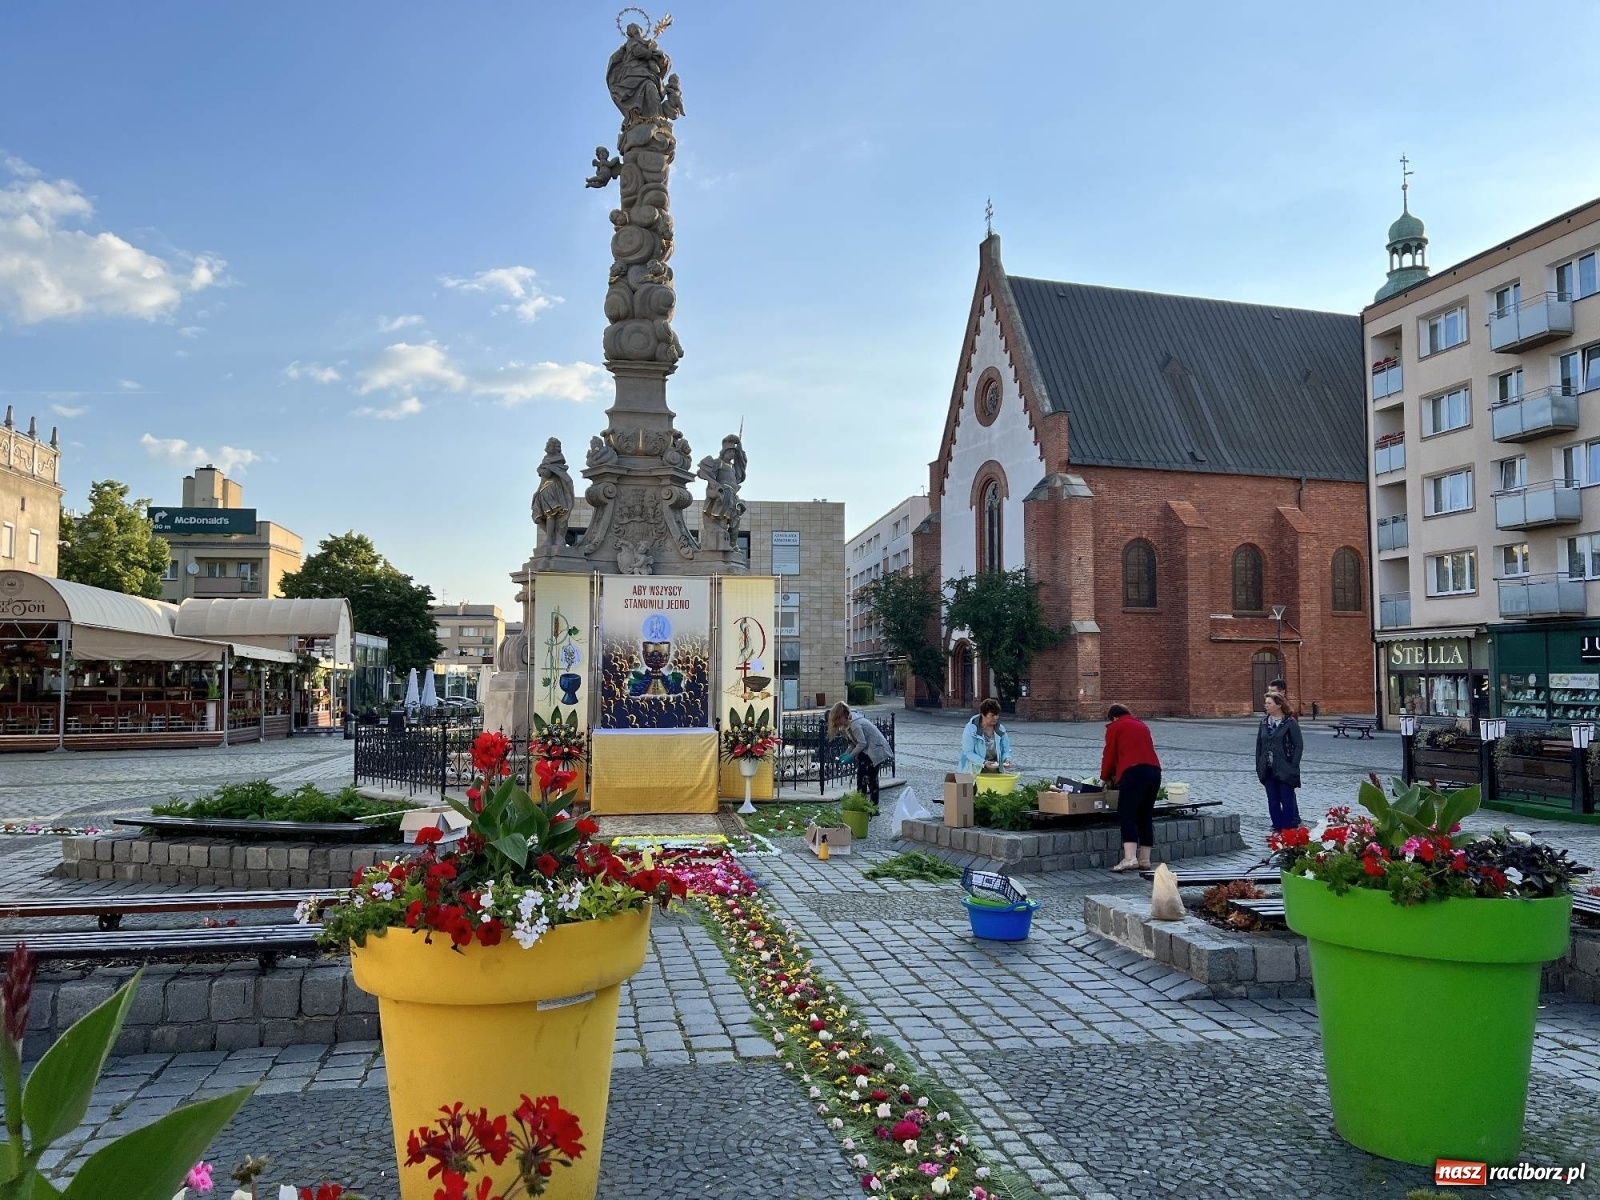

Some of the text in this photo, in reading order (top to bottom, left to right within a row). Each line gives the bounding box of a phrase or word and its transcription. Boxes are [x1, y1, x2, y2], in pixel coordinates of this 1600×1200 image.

[174, 516, 230, 525] McDonald's
[632, 585, 683, 597] ABY WSZYSCY
[624, 598, 690, 610] STANOWILI JEDNO
[1391, 642, 1464, 665] STELLA
